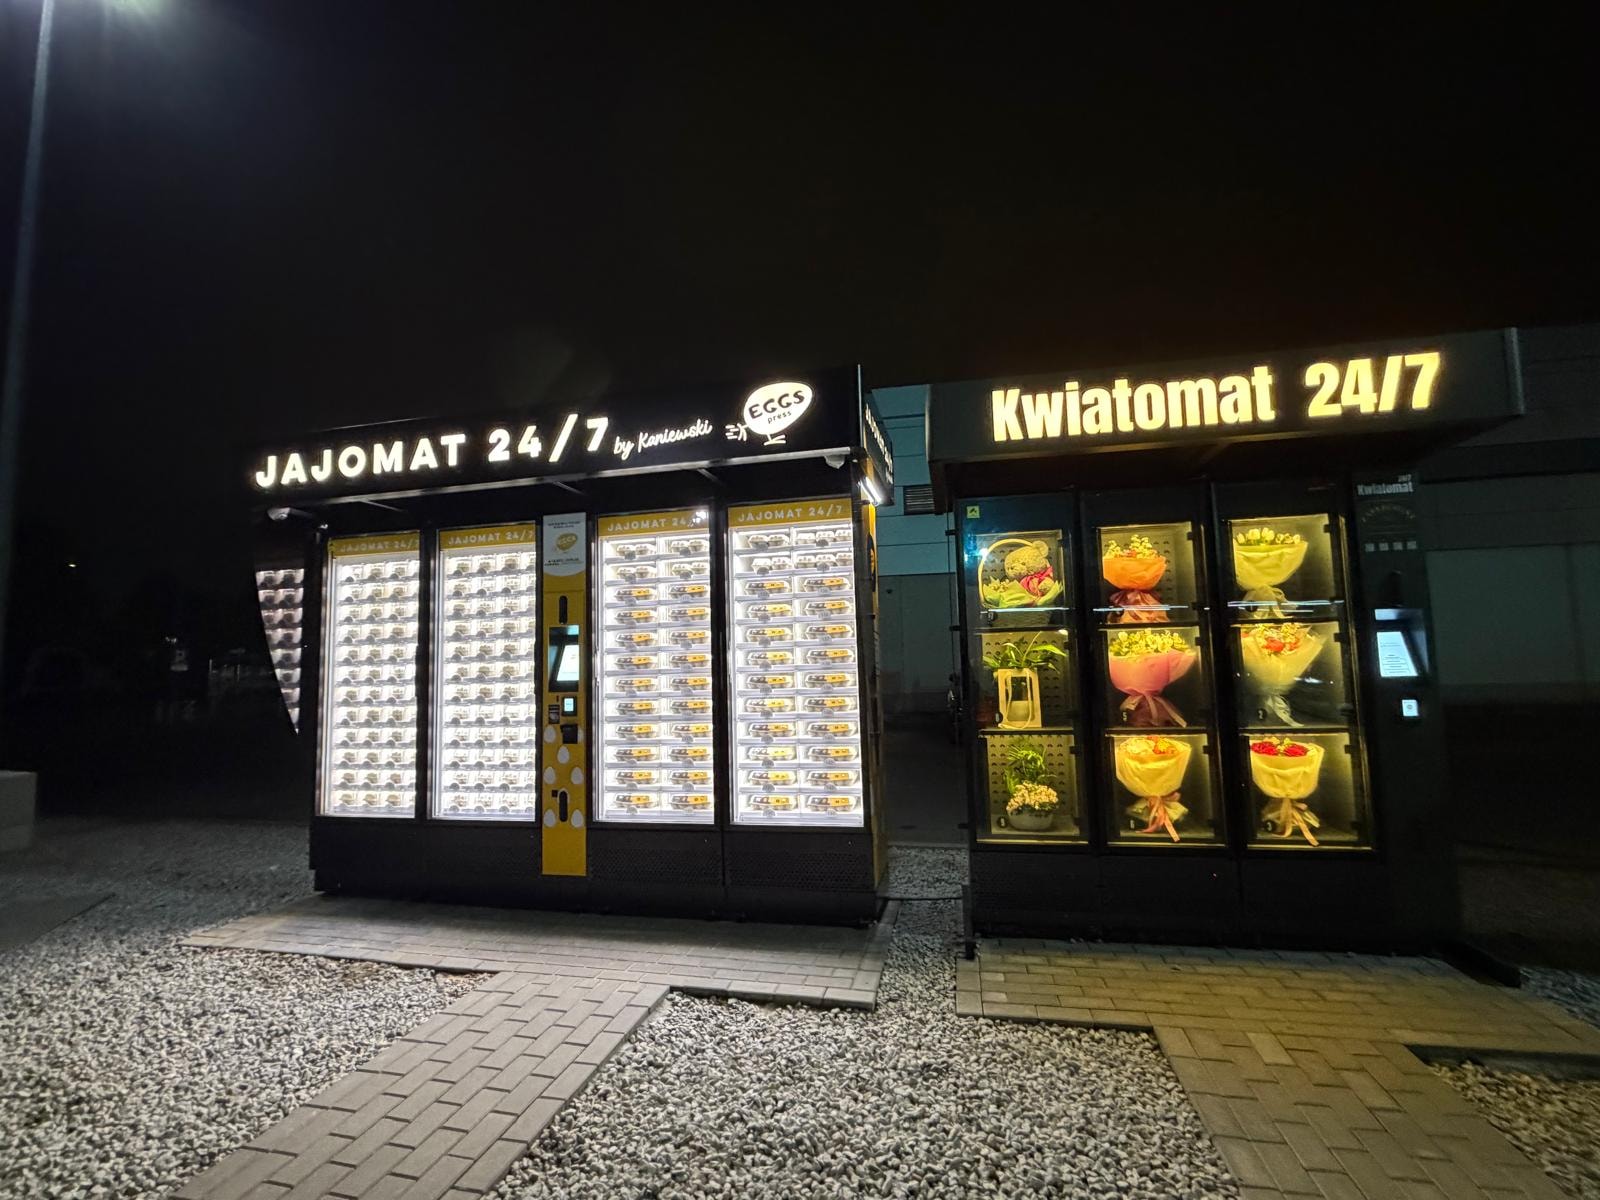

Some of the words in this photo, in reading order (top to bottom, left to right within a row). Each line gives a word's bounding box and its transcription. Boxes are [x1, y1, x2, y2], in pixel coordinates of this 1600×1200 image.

[748, 390, 805, 419] EGGS
[992, 366, 1276, 442] Kwiatomat
[1304, 352, 1440, 417] 24/7
[767, 410, 792, 425] press
[255, 434, 466, 488] JAJOMAT
[488, 413, 609, 463] 24/7
[614, 436, 635, 461] by
[638, 418, 713, 453] Kaniewski
[738, 508, 803, 523] JAJOMAT
[808, 503, 842, 518] 24/7
[608, 518, 666, 532] JAJOMAT
[448, 532, 501, 546] JAJOMAT
[506, 529, 534, 541] 24/7
[340, 541, 389, 553] JAJOMAT
